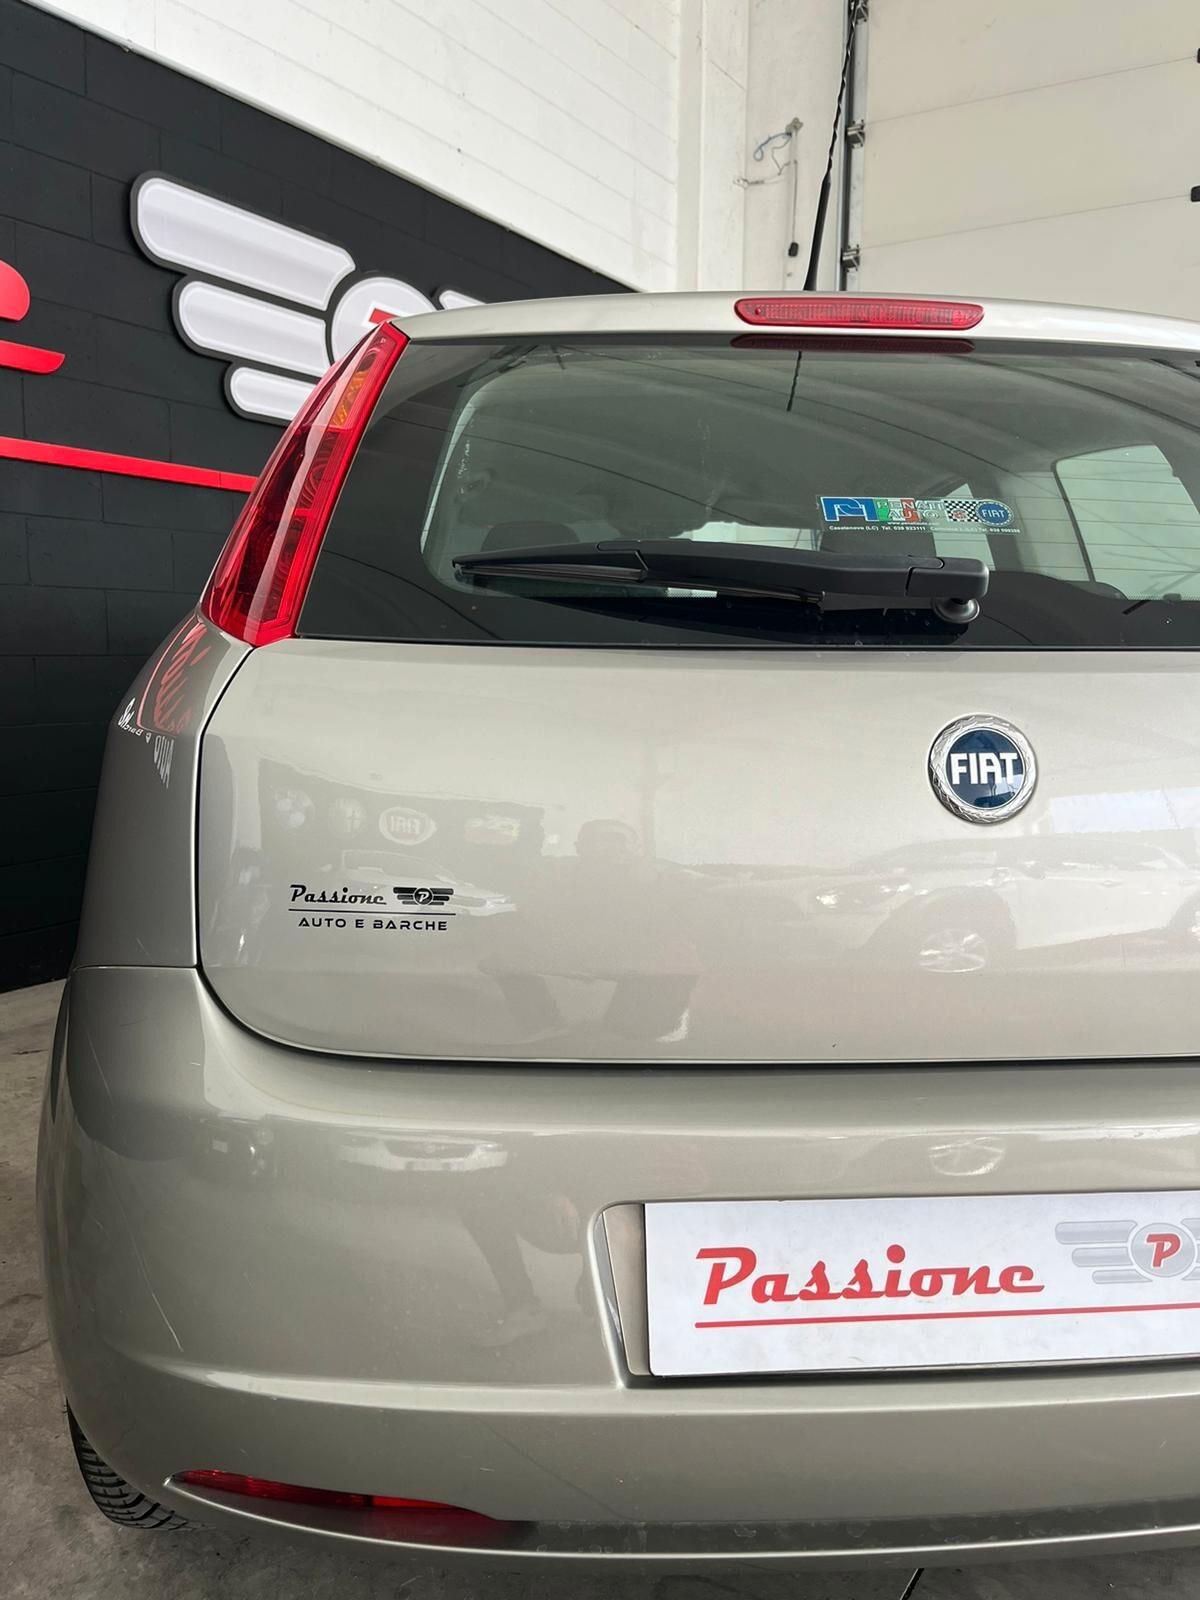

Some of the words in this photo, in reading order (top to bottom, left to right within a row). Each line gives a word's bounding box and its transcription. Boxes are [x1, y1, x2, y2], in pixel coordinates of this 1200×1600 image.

[981, 508, 1006, 519] FIAT
[950, 752, 1018, 785] FIAT
[290, 884, 387, 905] Passione
[298, 917, 346, 928] AUTO
[356, 919, 364, 928] E
[373, 919, 448, 930] BARCHE
[695, 1243, 1045, 1305] Passione
[1145, 1233, 1181, 1267] P
